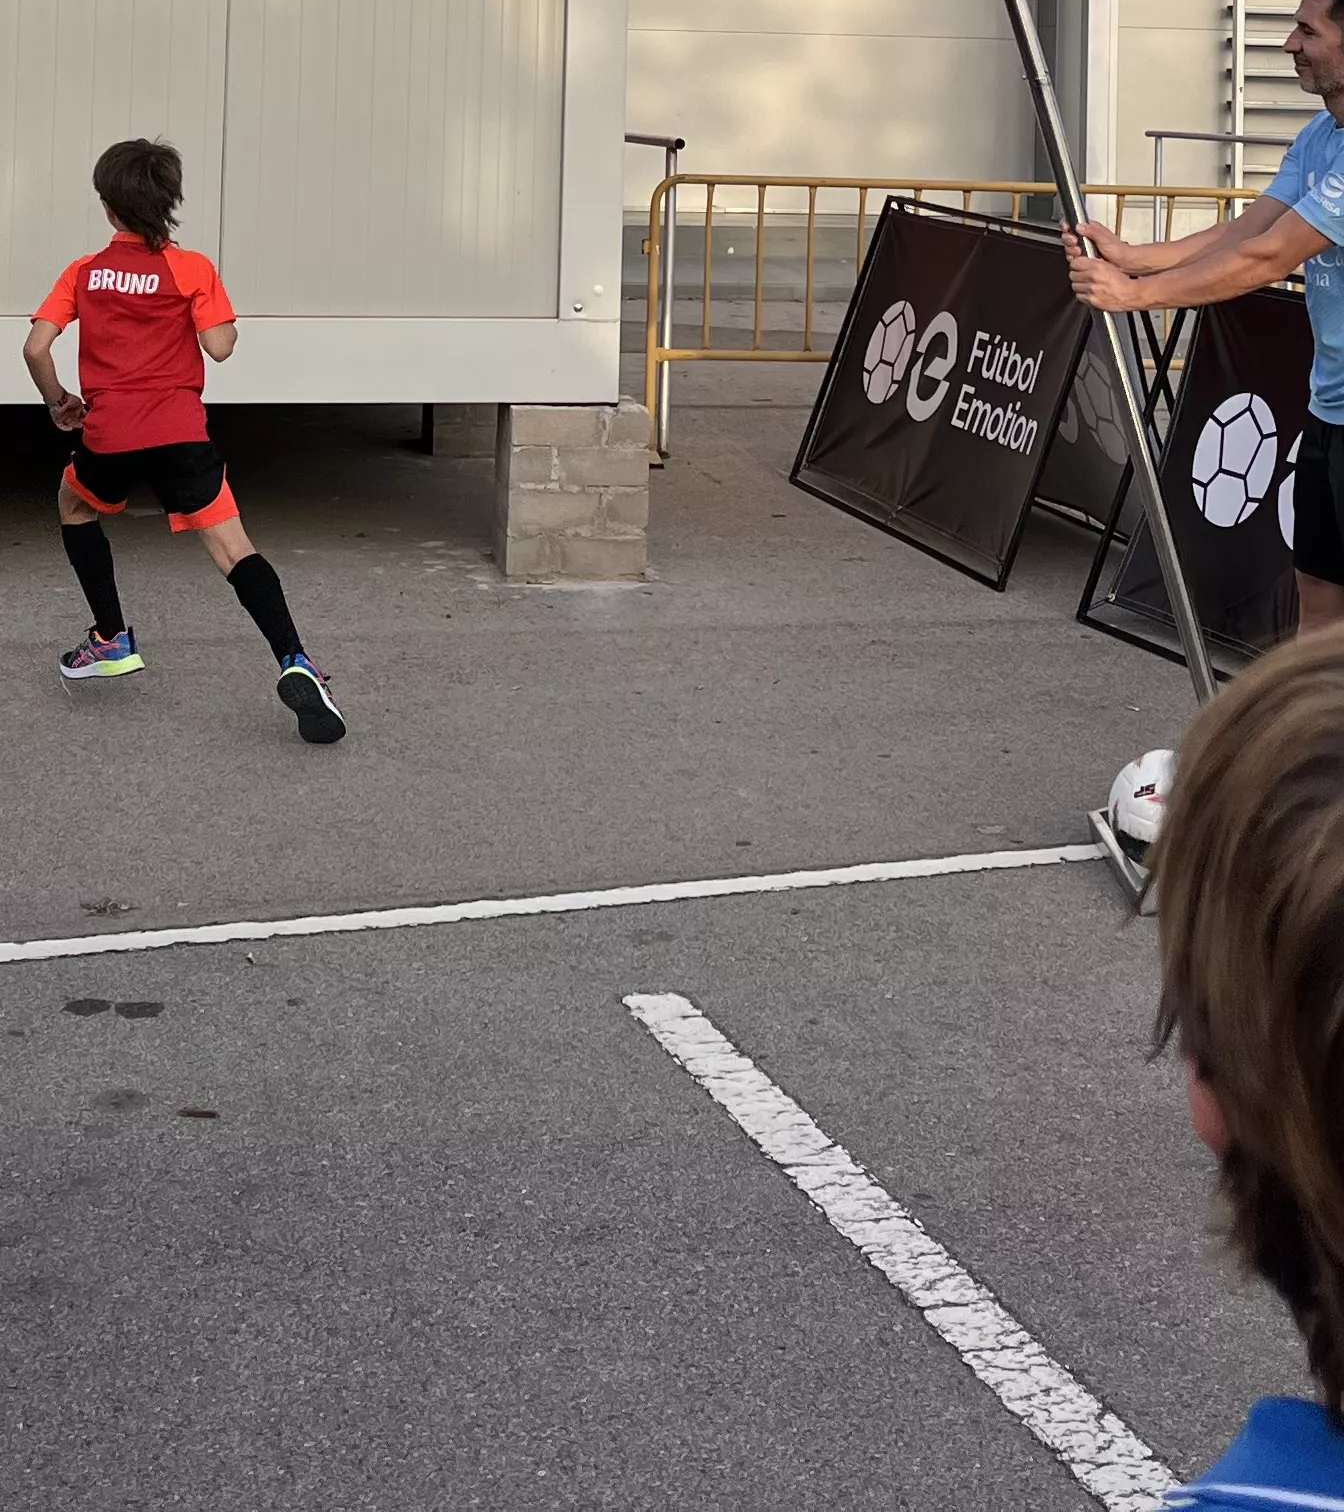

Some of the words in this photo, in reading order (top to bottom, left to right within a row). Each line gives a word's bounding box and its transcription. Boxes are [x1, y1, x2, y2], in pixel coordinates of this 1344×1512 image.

[87, 268, 160, 295] BRUNO
[966, 329, 1044, 395] Fútbol
[950, 384, 1040, 456] Emotion
